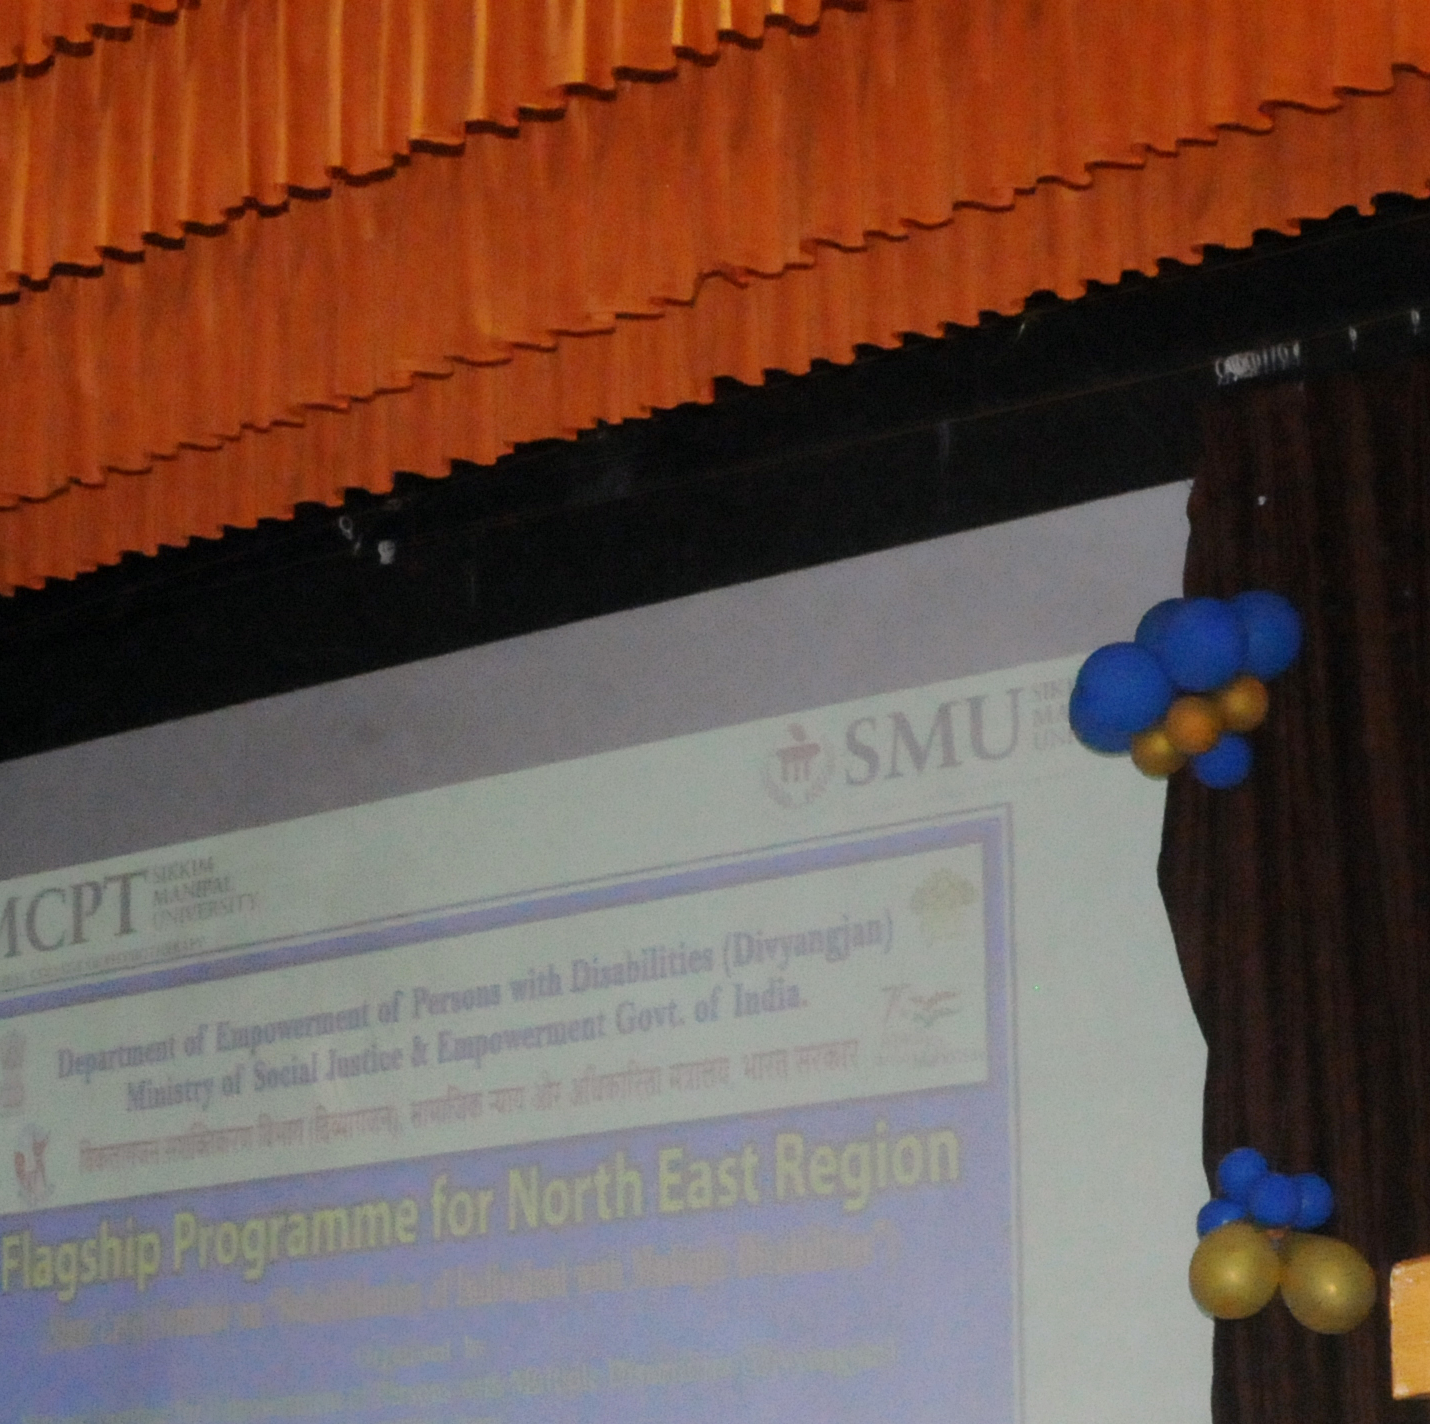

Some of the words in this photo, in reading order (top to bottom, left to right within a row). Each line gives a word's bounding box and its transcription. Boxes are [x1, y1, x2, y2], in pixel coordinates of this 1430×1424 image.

[844, 688, 1024, 787] SMU
[58, 1036, 175, 1085] Department
[184, 1024, 207, 1057] of
[215, 1002, 370, 1056] Empowerment
[378, 989, 404, 1021] of
[411, 981, 501, 1020] Persons
[511, 964, 562, 1002] with
[569, 943, 714, 993] Disabilities
[722, 908, 894, 978] (Divyangjan)
[126, 1074, 214, 1114] Ministry
[221, 1069, 246, 1096] of
[253, 1050, 317, 1091] Social
[326, 1042, 403, 1080] Justice
[411, 1035, 429, 1067] &
[437, 1009, 605, 1068] Empowerment
[615, 998, 684, 1035] Govt.
[695, 989, 722, 1023] of
[0, 1222, 161, 1303] Flagship
[175, 1192, 419, 1281] Programme
[431, 1174, 494, 1241] for
[507, 1148, 645, 1232] North
[658, 1143, 761, 1213] East
[775, 1121, 959, 1212] Region
